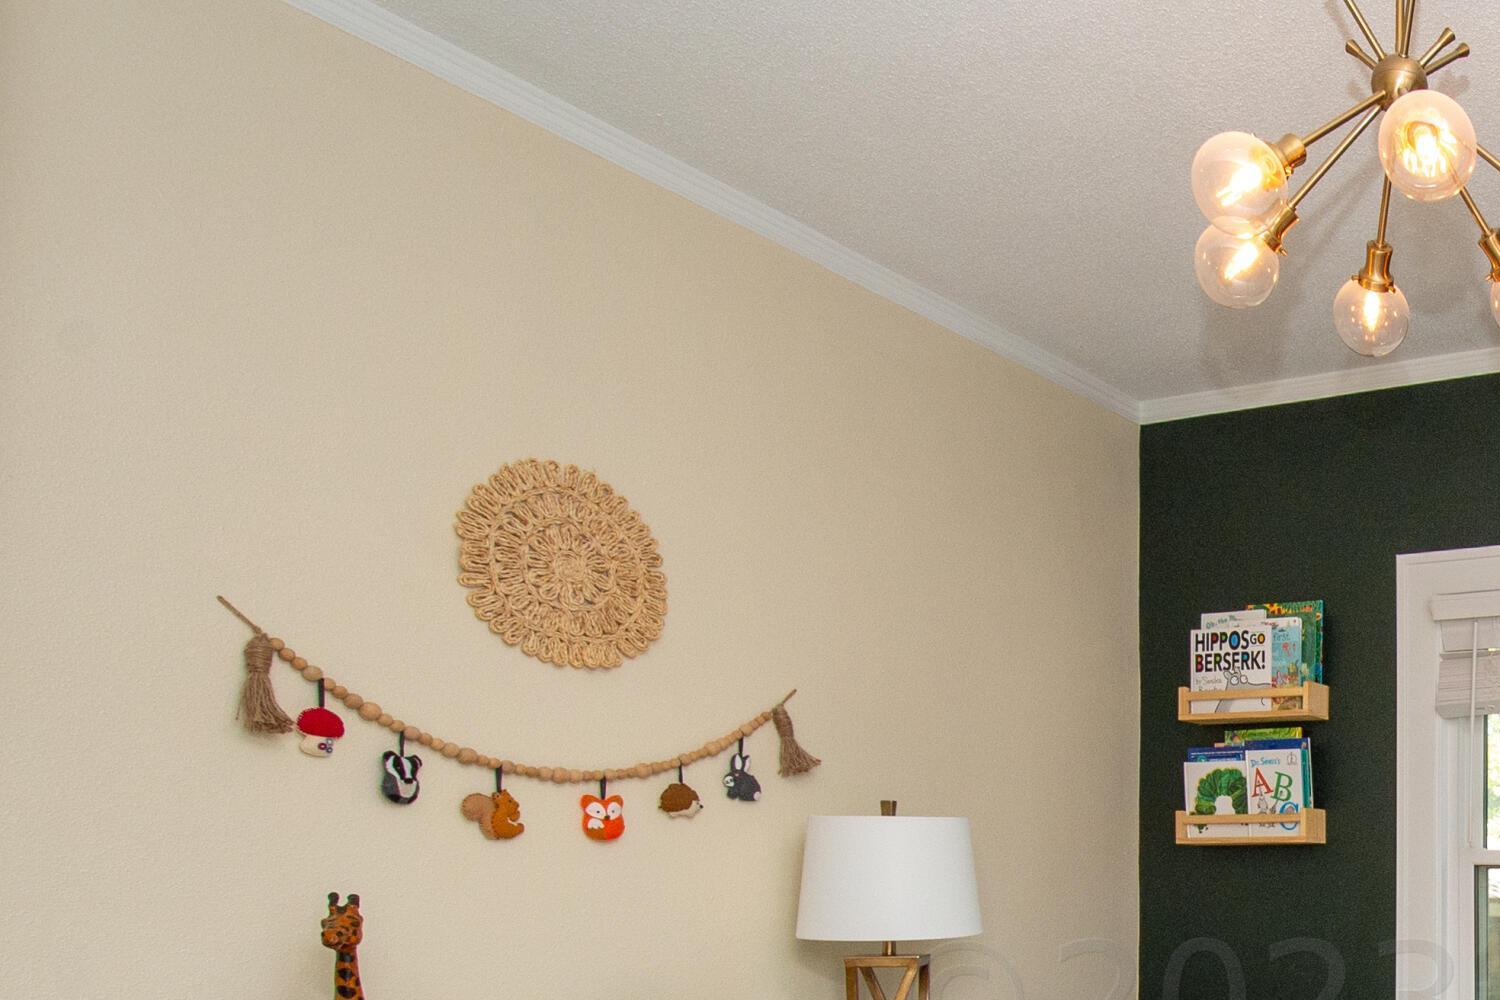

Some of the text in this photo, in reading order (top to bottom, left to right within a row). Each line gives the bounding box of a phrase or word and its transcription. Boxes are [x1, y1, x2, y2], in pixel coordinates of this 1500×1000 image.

[1195, 630, 1265, 652] HIPPOS GO
[1195, 650, 1266, 673] BERSERK!
